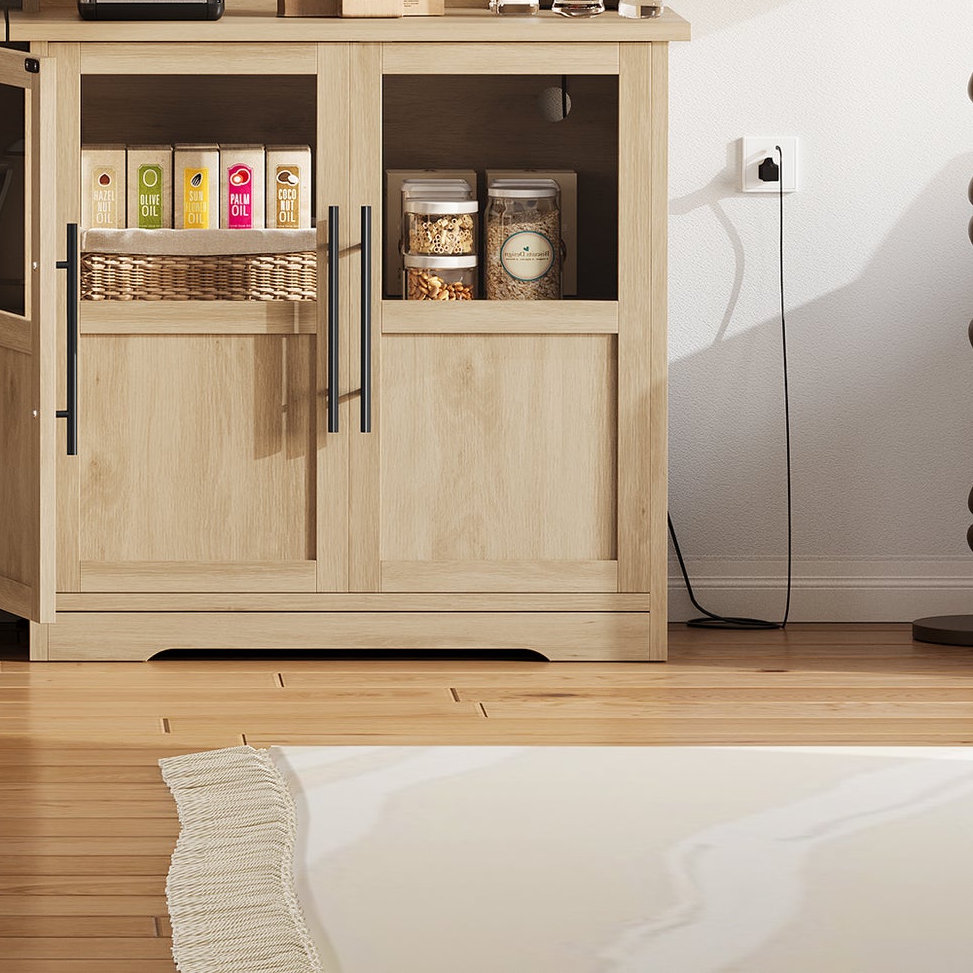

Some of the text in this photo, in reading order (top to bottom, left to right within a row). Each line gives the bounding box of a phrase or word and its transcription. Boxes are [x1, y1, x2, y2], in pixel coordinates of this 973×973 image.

[93, 190, 115, 201] HAZEL
[140, 194, 160, 206] OLIVE
[189, 191, 204, 201] SUN
[230, 193, 250, 205] PALM
[278, 189, 297, 200] COCO
[97, 201, 112, 212] NUT
[231, 205, 249, 217] OIL
[280, 200, 294, 211] NUT
[141, 206, 159, 217] OIL
[279, 211, 296, 222] OIL
[96, 212, 113, 224] OIL
[188, 212, 205, 224] OIL
